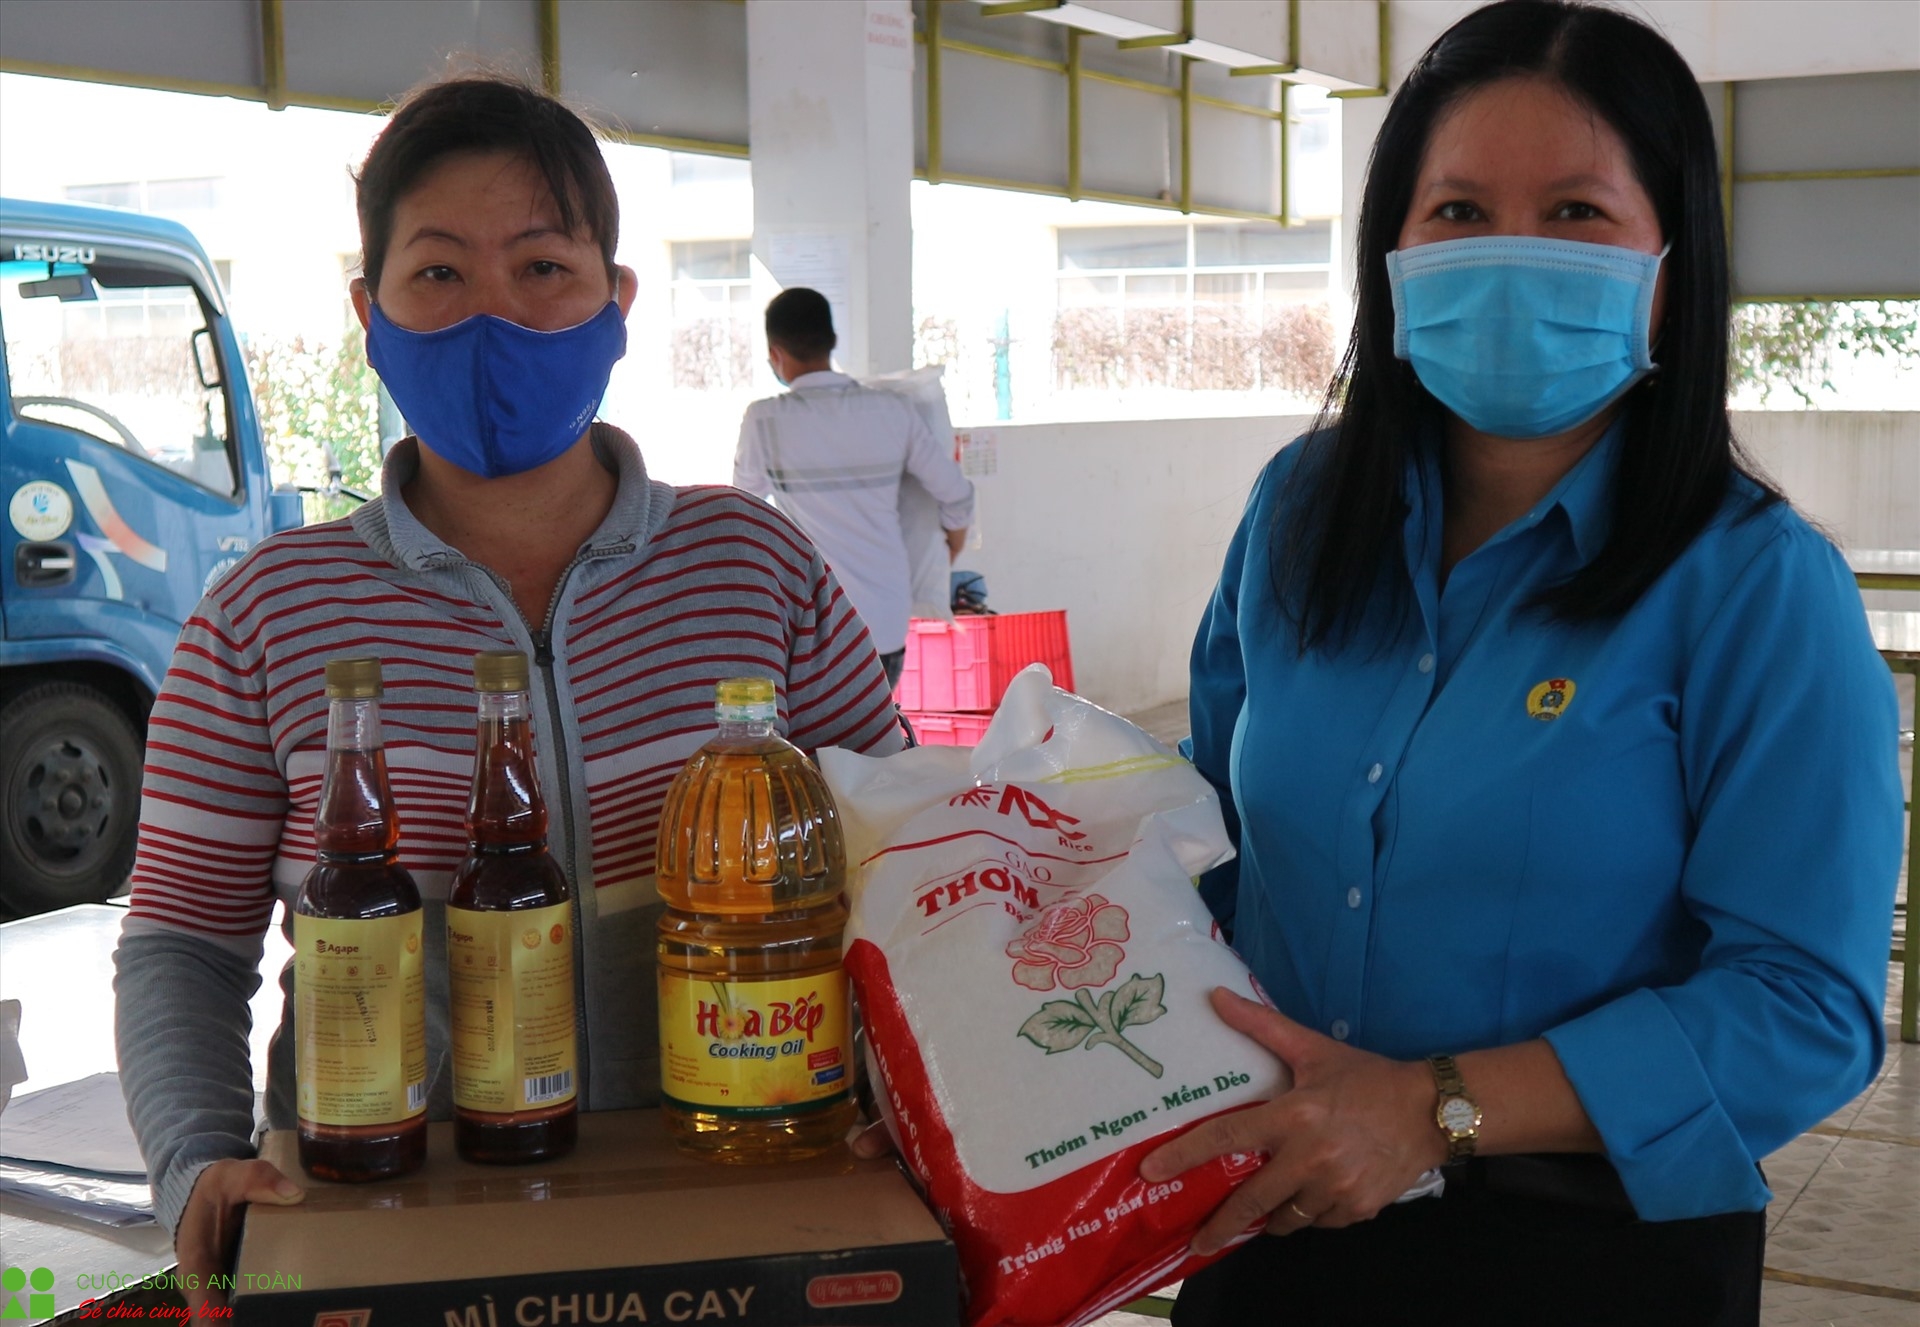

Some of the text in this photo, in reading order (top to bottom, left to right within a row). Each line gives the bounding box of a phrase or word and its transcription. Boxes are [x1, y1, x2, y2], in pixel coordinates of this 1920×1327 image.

[14, 244, 96, 264] ISUZU
[1058, 836, 1094, 852] Rice
[916, 866, 1040, 917] THƠM
[327, 944, 359, 954] Agape
[452, 932, 473, 943] Agape
[696, 991, 824, 1043] Hoa Bếp
[708, 1039, 804, 1061] Cooking Oil
[1025, 1134, 1087, 1170] Thơm
[1090, 1108, 1148, 1141] Ngon
[1161, 1085, 1212, 1110] Mềm
[1213, 1070, 1251, 1092] Dẻo
[998, 1180, 1184, 1275] Trồng lúa bán gạo
[444, 1286, 755, 1327] MÌ CHUA CAY
